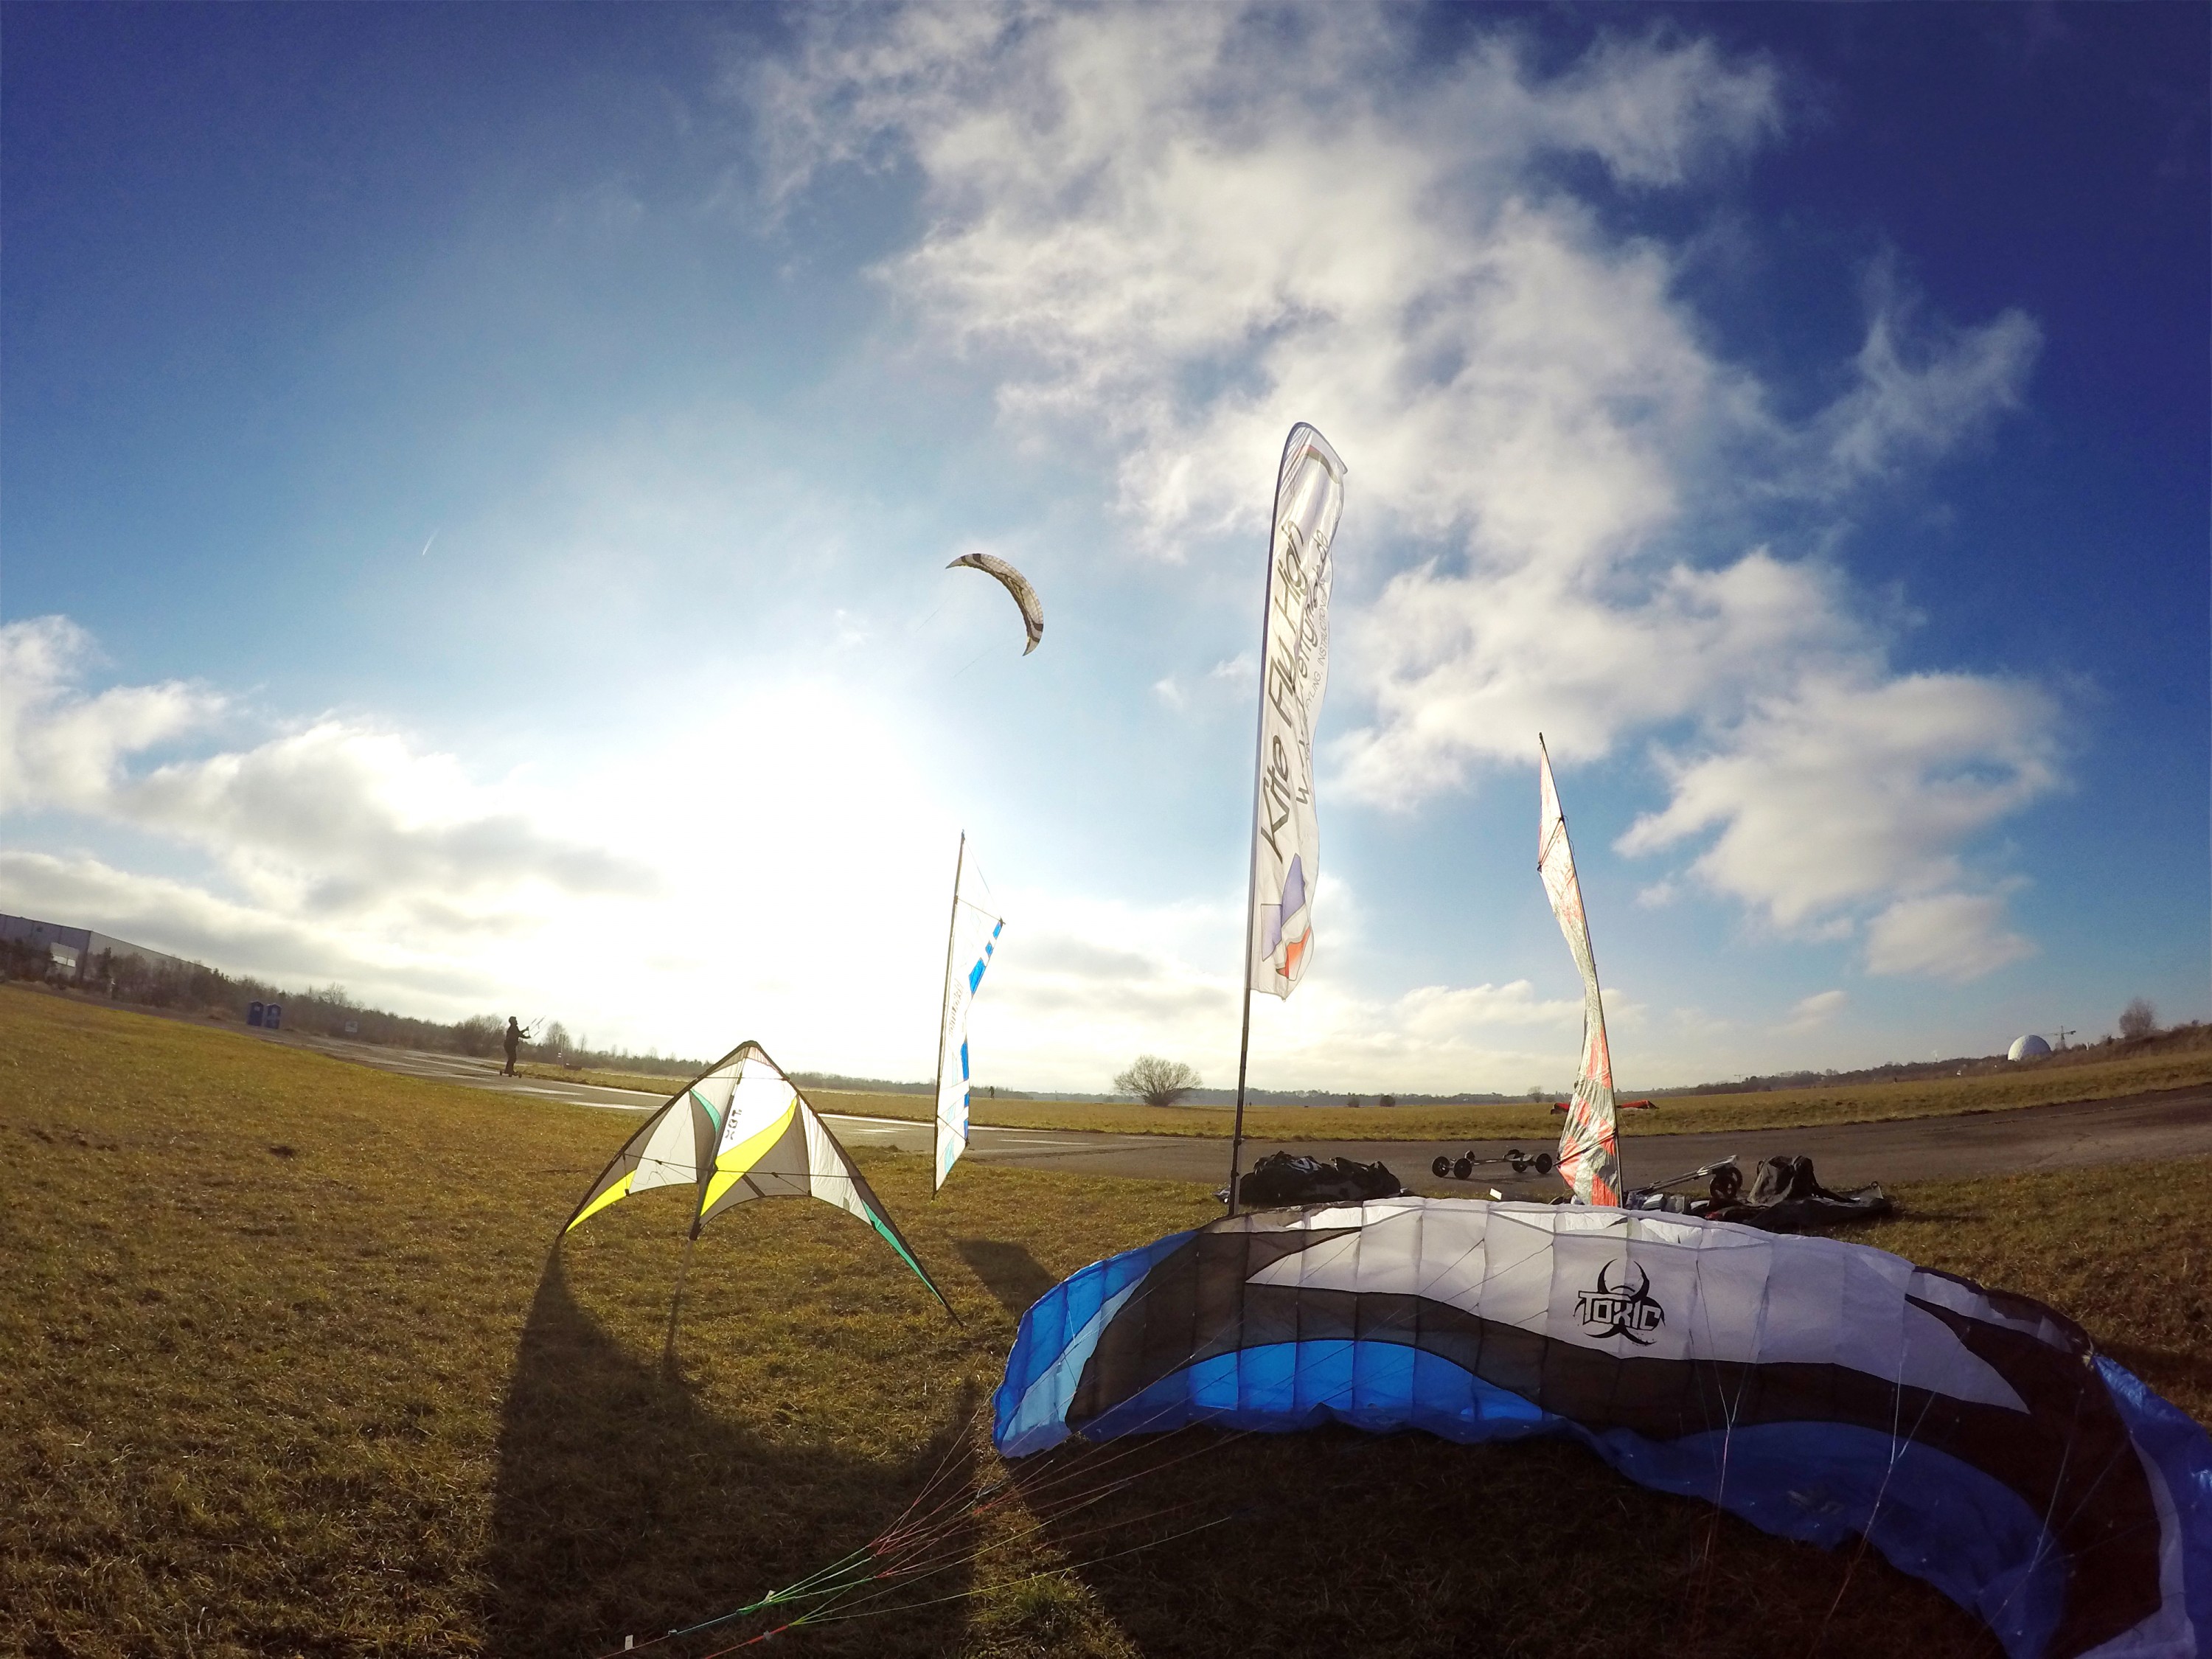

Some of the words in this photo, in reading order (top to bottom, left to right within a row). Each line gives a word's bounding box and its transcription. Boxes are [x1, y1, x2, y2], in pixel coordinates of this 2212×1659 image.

[1275, 521, 1308, 633] High
[1268, 636, 1296, 728] Fly
[1261, 735, 1290, 864] Kite
[1577, 1291, 1662, 1331] TOXIC
